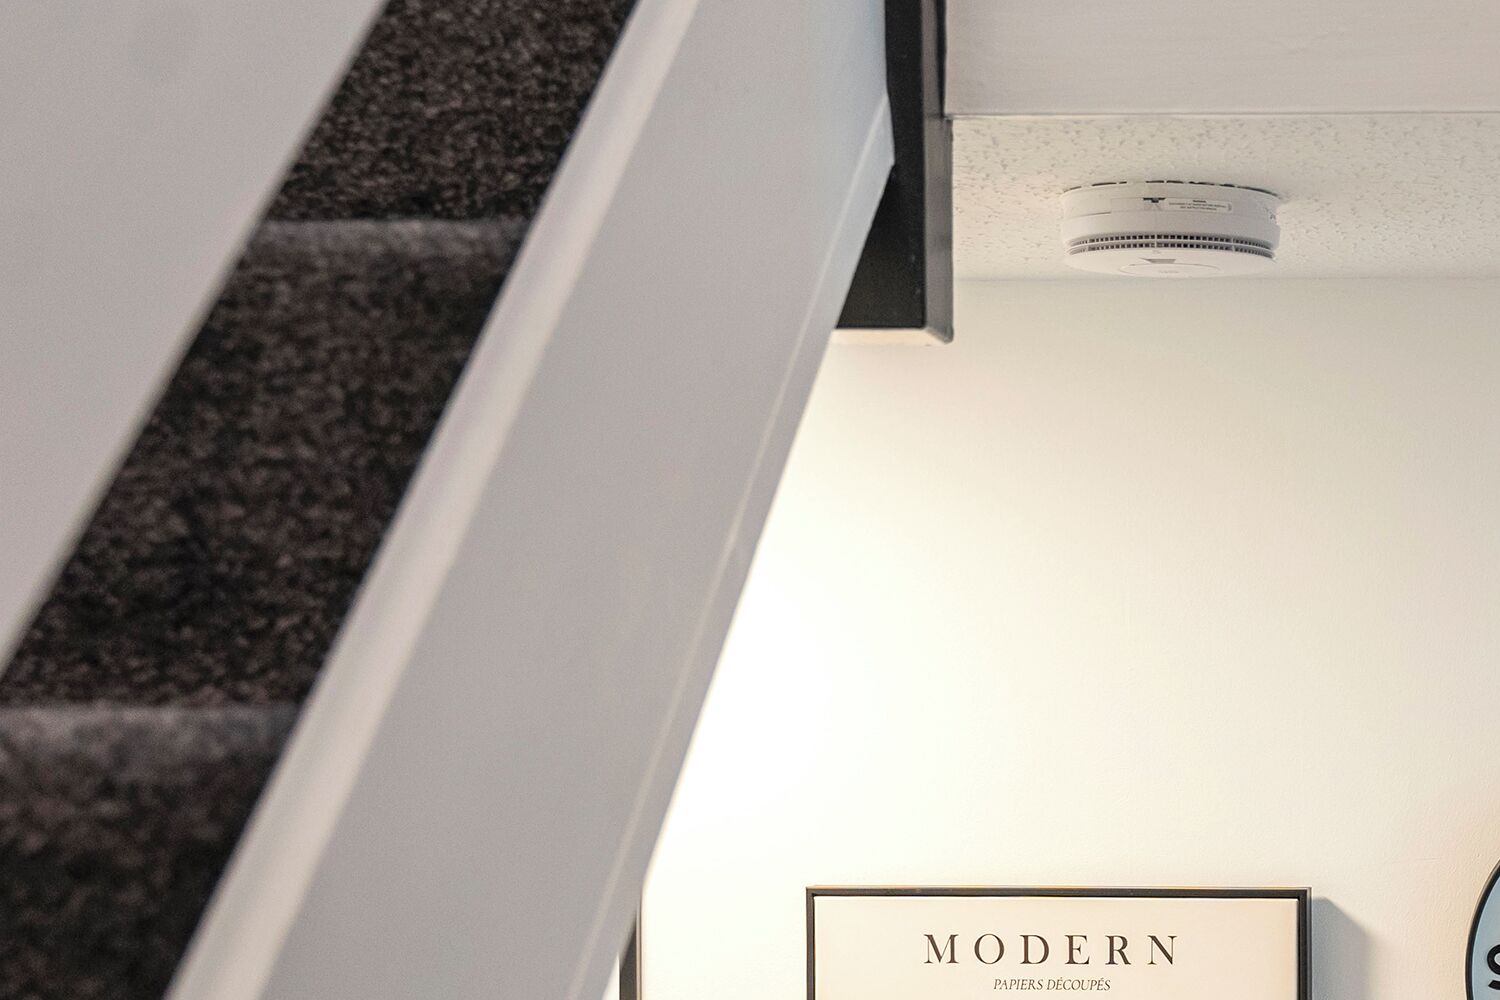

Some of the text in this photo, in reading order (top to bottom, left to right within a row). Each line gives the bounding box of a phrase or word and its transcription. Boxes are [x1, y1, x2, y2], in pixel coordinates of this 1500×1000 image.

[923, 933, 1177, 966] MODERN
[993, 976, 1111, 992] PAPIERS DÉCOUPÉS
